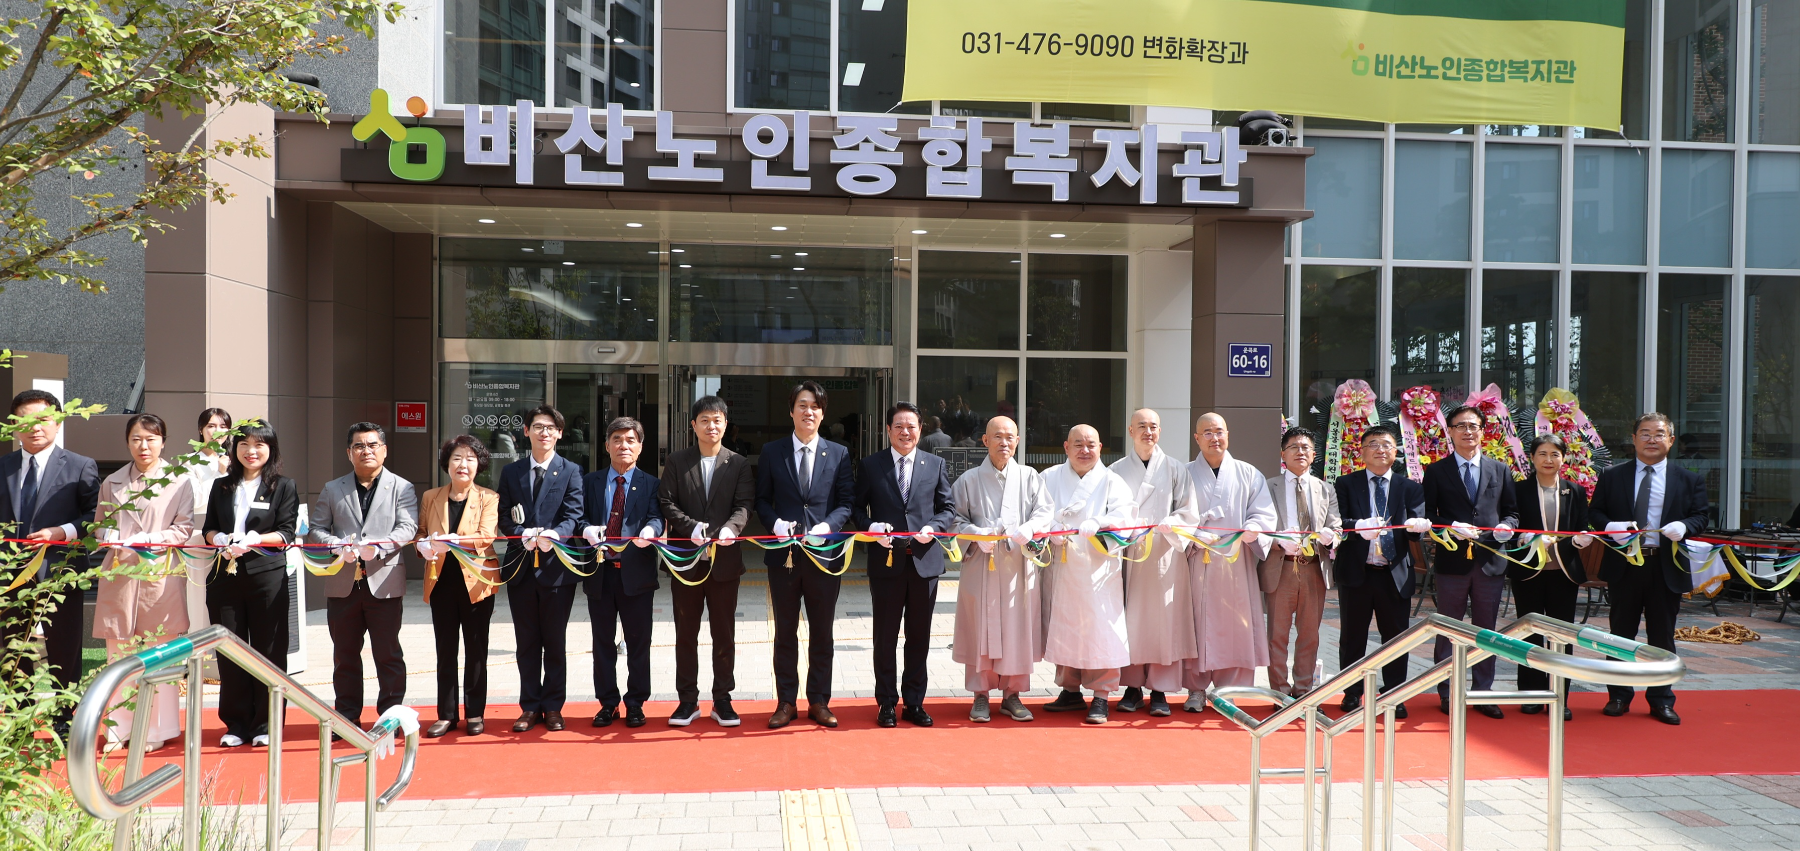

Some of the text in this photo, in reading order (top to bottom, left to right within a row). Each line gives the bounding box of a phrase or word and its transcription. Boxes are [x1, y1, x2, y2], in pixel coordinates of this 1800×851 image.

[961, 31, 1249, 65] 031-476-9090 변화확장과
[1373, 53, 1577, 84] 비산노인종합복지관
[463, 99, 1248, 204] 비산노인종합복지관
[1232, 354, 1268, 368] 60-16
[401, 412, 422, 420] 에스원
